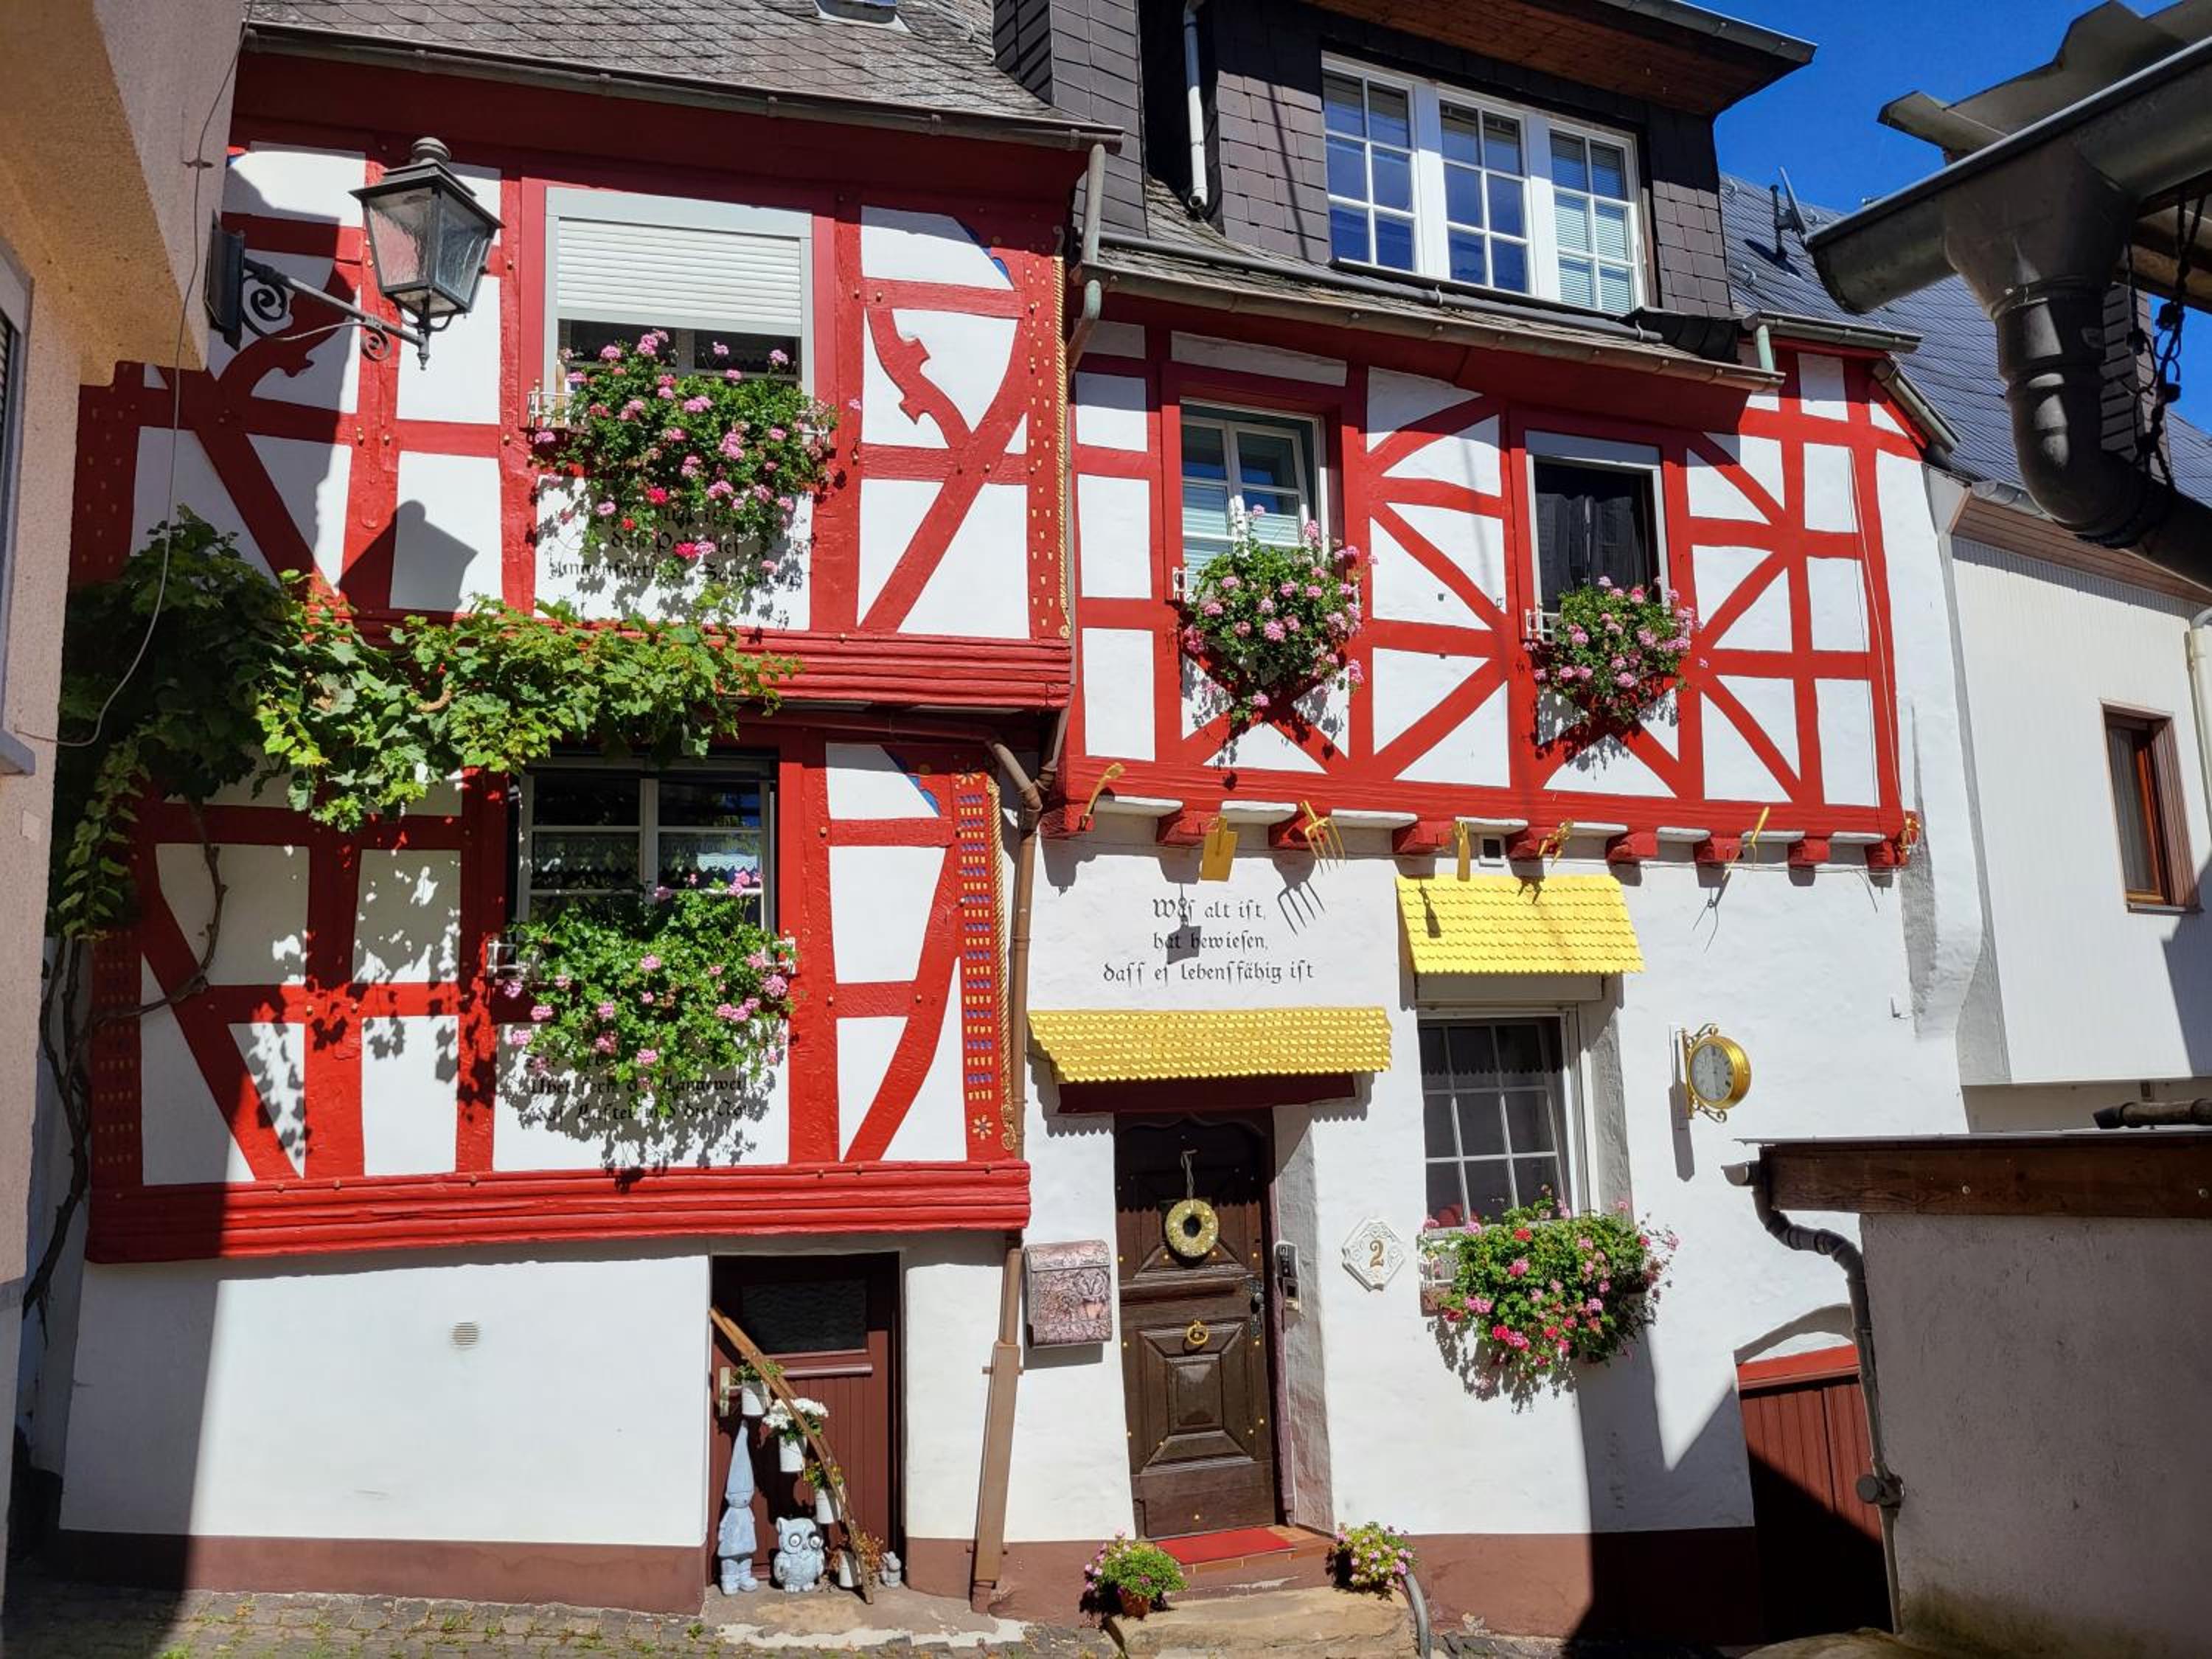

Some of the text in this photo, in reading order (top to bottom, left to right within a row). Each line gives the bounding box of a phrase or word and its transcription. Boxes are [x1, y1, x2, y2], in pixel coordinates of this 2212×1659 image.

[1204, 901, 1231, 918] alt
[1153, 931, 1180, 951] hat
[1368, 1239, 1385, 1267] 2
